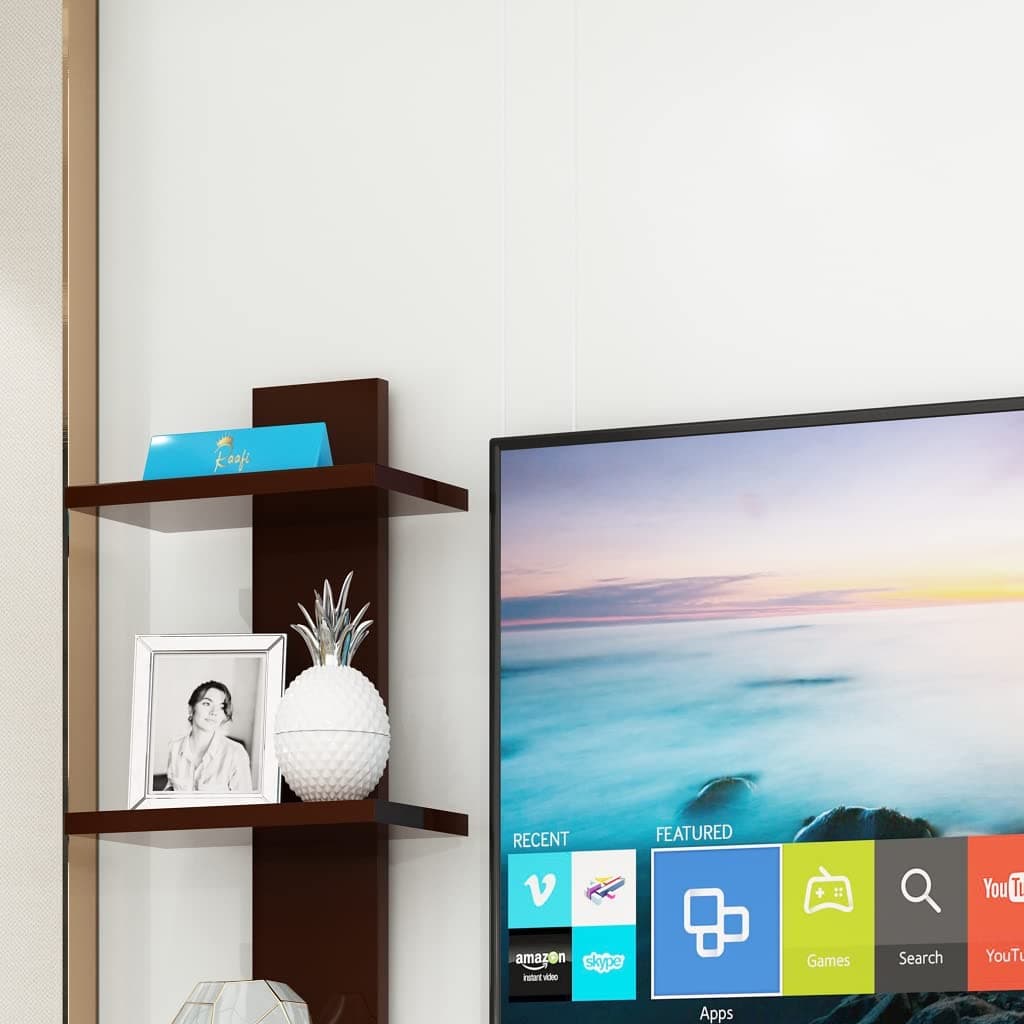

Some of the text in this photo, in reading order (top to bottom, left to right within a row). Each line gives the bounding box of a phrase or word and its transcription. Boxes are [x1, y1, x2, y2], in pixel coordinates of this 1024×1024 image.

[213, 444, 251, 473] Raafi
[513, 831, 570, 848] RECENT
[656, 824, 733, 842] FEATURED
[585, 955, 622, 972] skype
[807, 953, 850, 968] Games
[899, 950, 944, 966] Search
[523, 973, 559, 982] instant video
[699, 1005, 734, 1024] Apps
